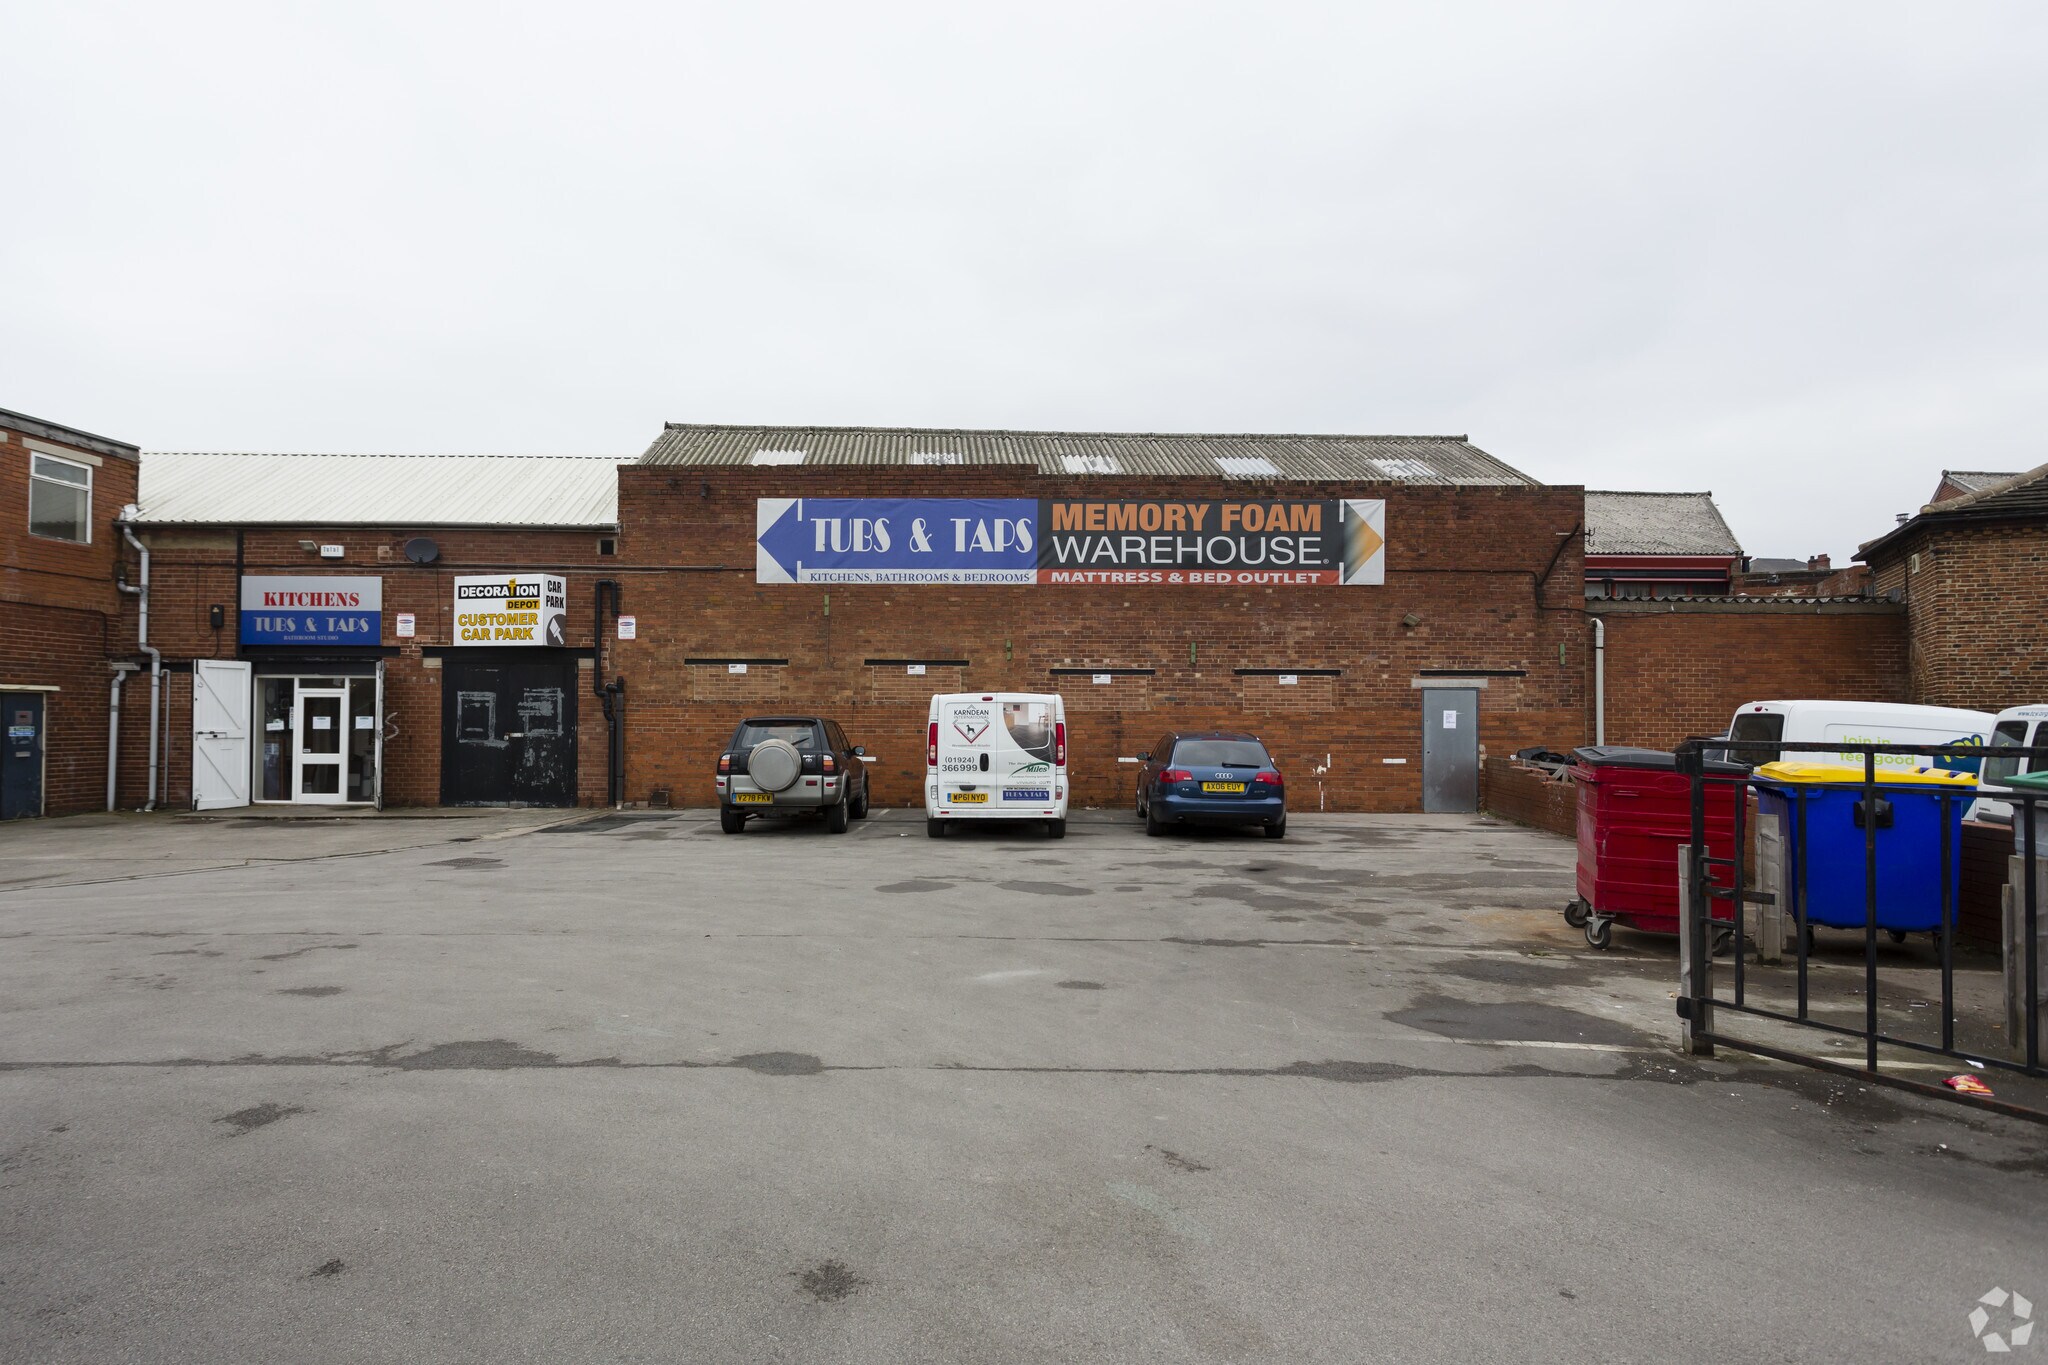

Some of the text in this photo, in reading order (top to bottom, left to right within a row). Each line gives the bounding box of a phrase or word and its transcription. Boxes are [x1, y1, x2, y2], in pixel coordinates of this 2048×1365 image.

[1052, 503, 1322, 532] MEMORY FOAM
[810, 517, 1033, 554] TUBS & TAPS
[1052, 536, 1322, 565] WAREHOUSE
[810, 572, 1030, 583] KITCHENS, BATHROOMS & BEDROOMS
[1051, 572, 1321, 584] MATTRESS & BED OUTLET
[460, 578, 538, 598] DECORATION
[547, 580, 562, 594] CAR
[263, 592, 360, 607] KITCHENS
[507, 600, 539, 609] DEPOT
[546, 595, 564, 609] PARK
[253, 617, 369, 632] TUBS & TAPS
[458, 613, 539, 627] CUSTOMER
[461, 627, 534, 641] CAR PARK
[944, 756, 975, 764] (01924)
[1840, 752, 1915, 766] fee good
[941, 764, 978, 772] 366999
[1206, 783, 1241, 791] AX06 EUY
[737, 794, 756, 802] V278
[953, 793, 986, 801] WP61 NYO
